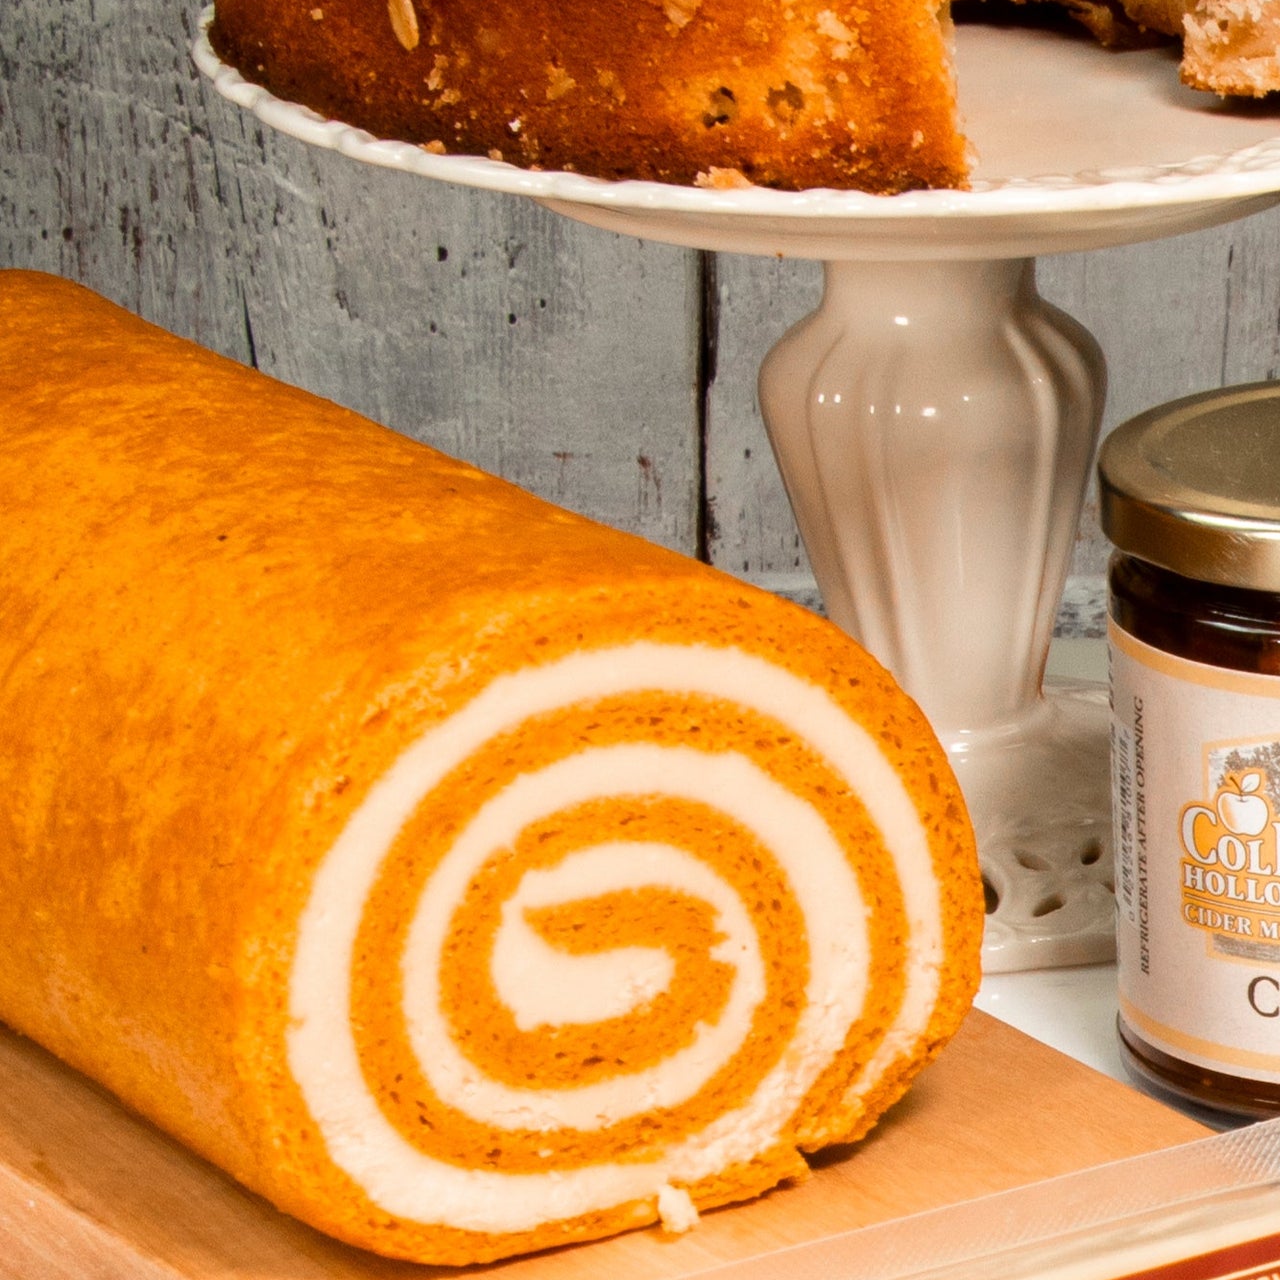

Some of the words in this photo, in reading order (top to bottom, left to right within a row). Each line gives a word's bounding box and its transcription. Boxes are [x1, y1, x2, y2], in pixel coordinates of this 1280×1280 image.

[1134, 696, 1145, 787] OPENING
[1137, 786, 1147, 852] AFTER
[1139, 854, 1150, 975] REFRIGERATE
[1183, 903, 1253, 937] CIDER
